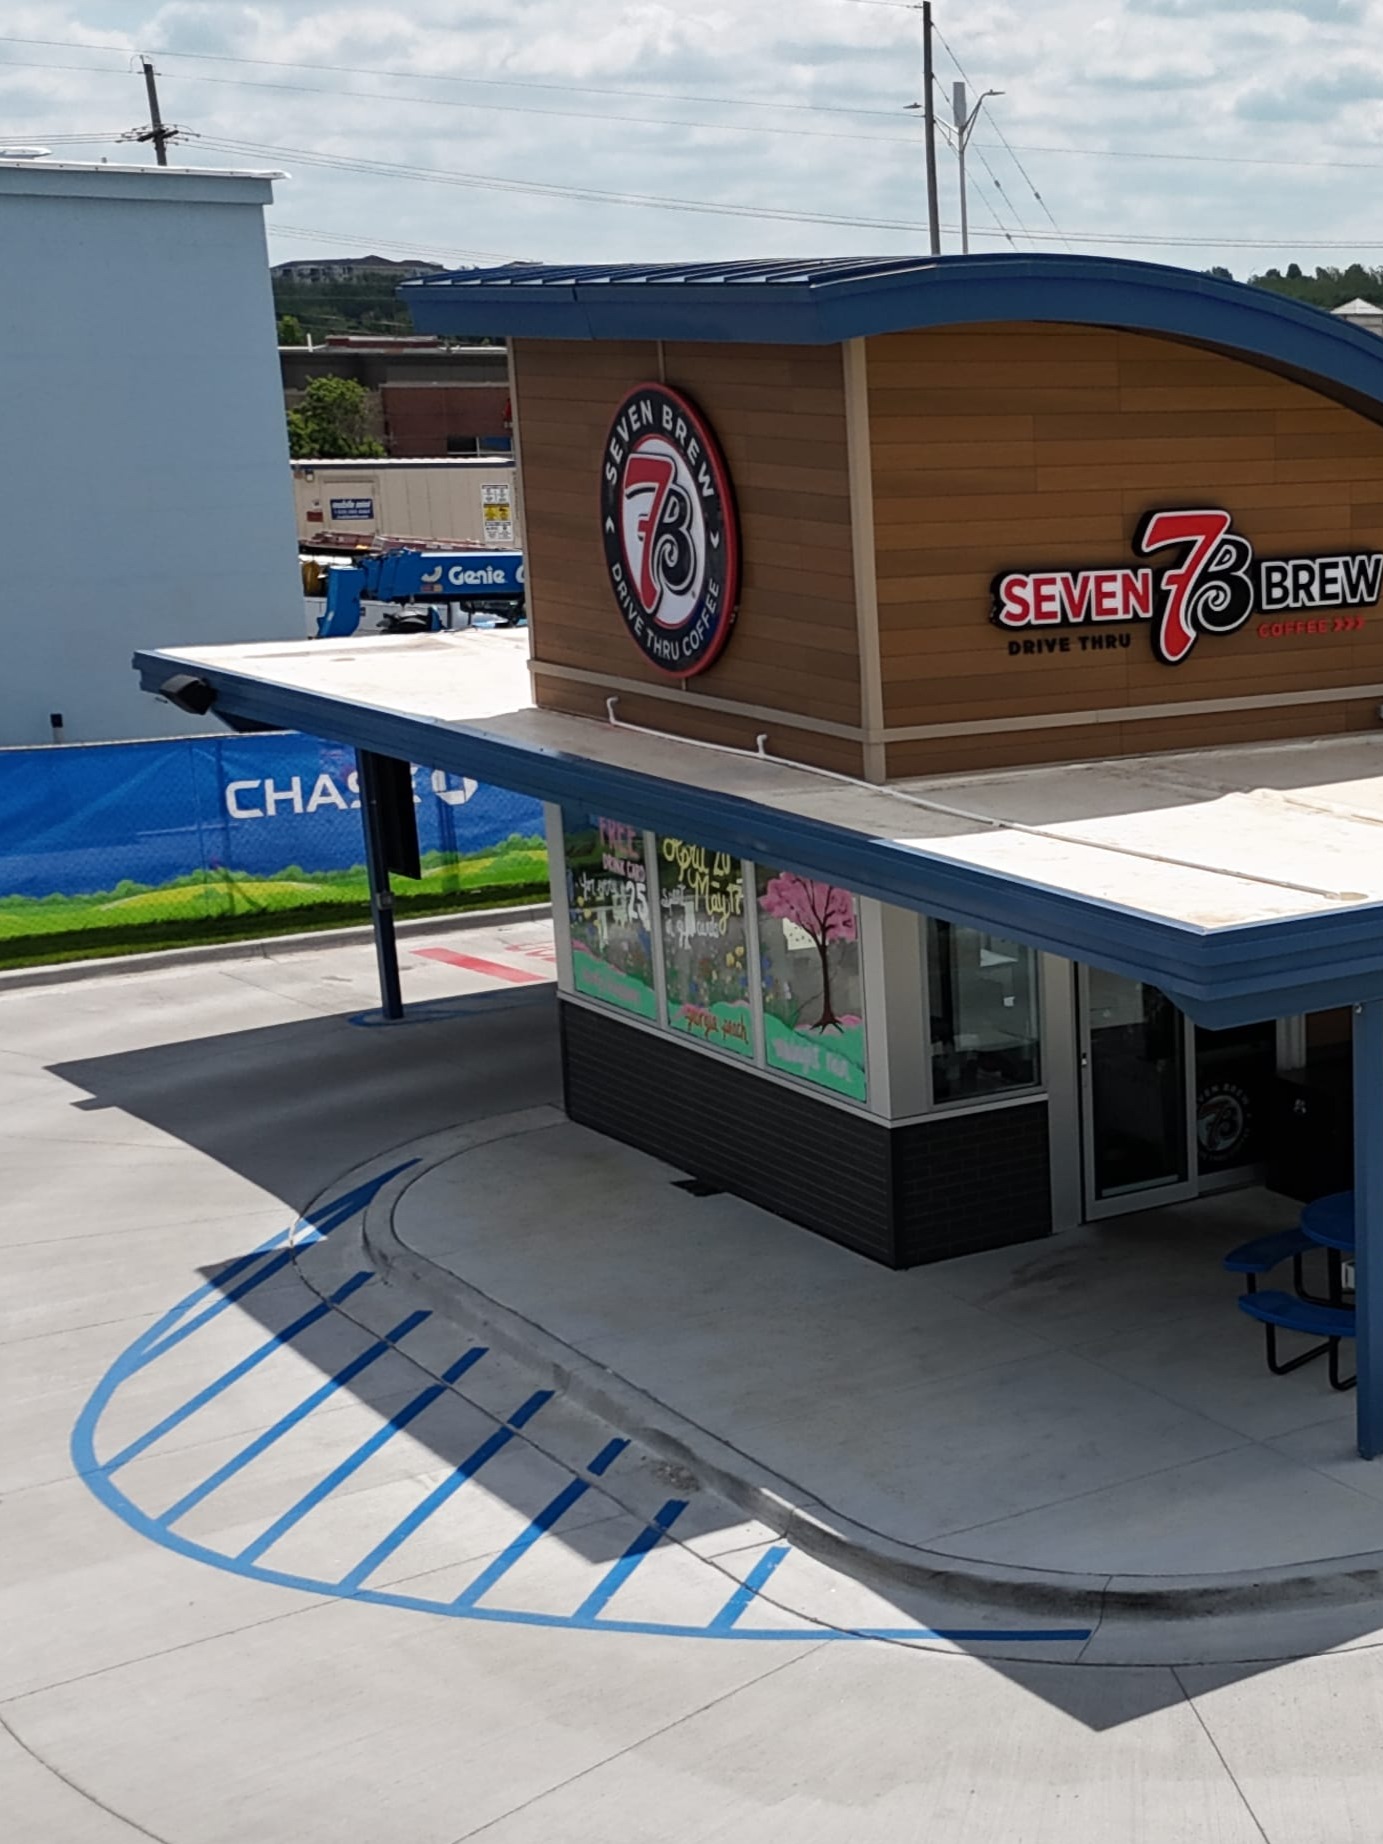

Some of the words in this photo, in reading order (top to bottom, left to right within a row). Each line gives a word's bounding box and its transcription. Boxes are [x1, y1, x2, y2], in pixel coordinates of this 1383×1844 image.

[605, 399, 653, 485] SEVEN
[661, 404, 714, 498] BREW
[448, 565, 505, 585] Genie
[611, 563, 643, 636] DRIVE
[645, 629, 680, 661] THRU
[682, 577, 720, 657] COFFEE
[999, 567, 1153, 627] SEVEN
[1008, 636, 1070, 656] DRIVE
[1079, 633, 1132, 652] THRU
[1258, 618, 1328, 638] COFFEE
